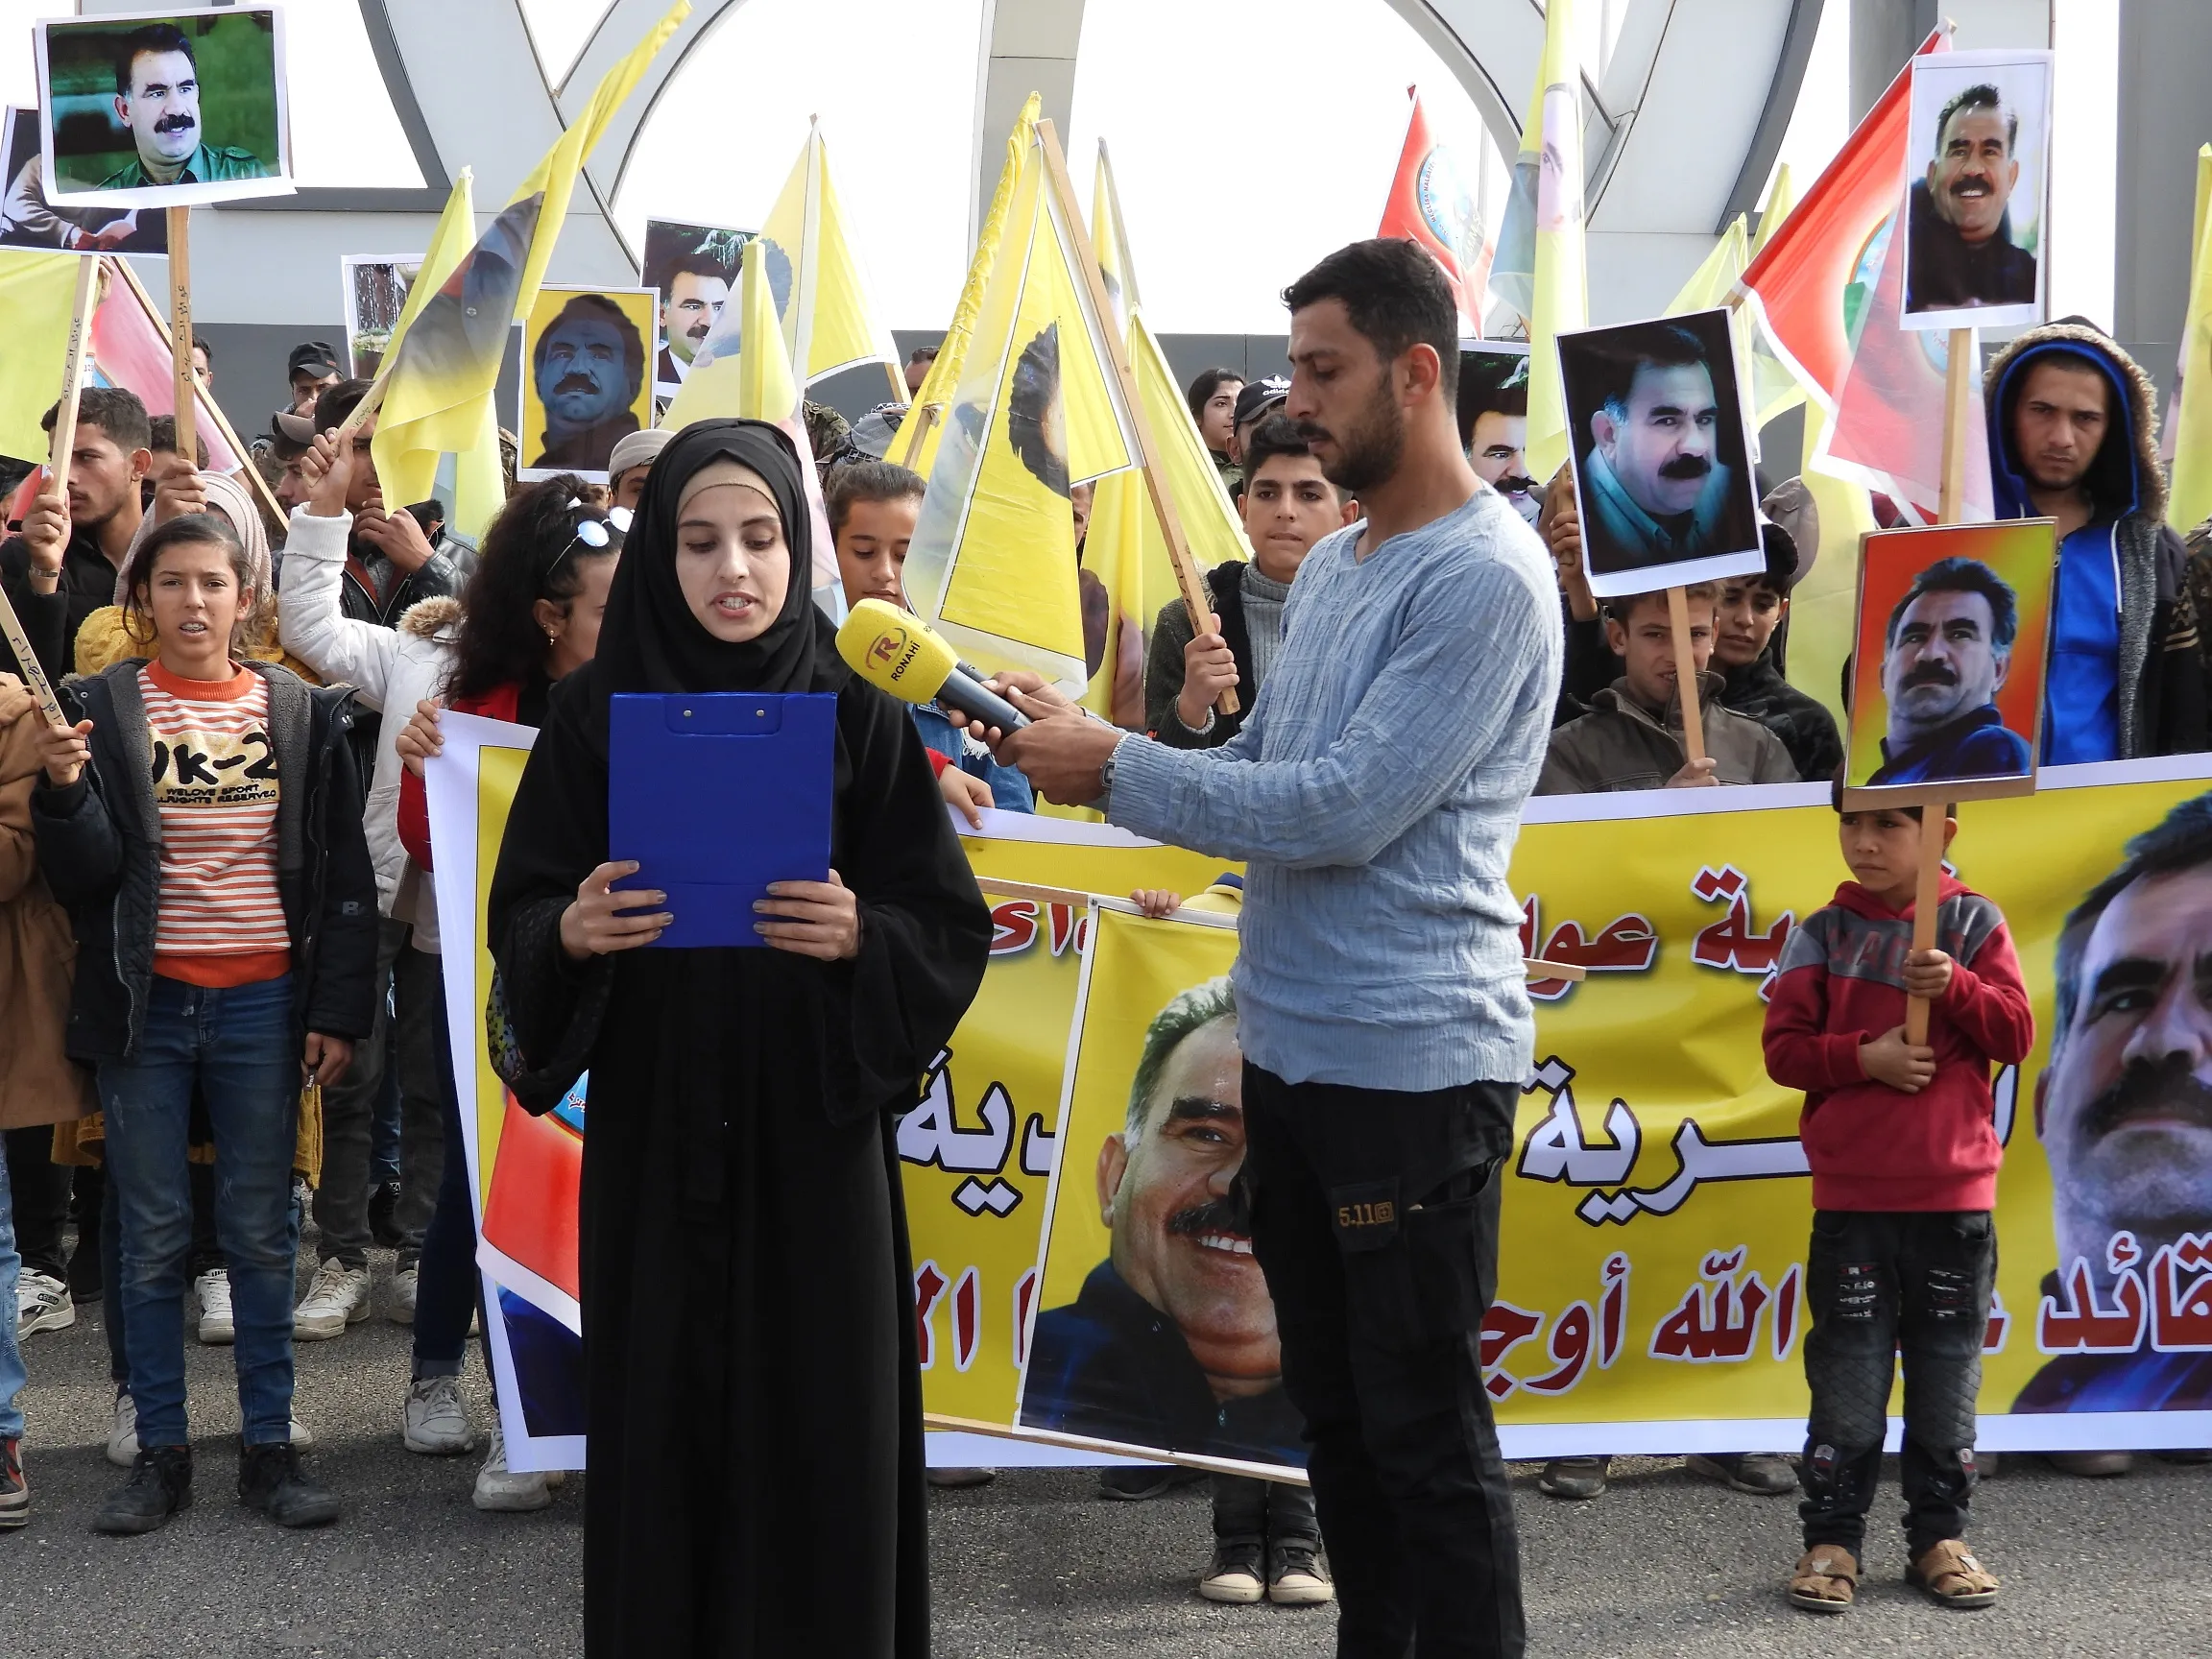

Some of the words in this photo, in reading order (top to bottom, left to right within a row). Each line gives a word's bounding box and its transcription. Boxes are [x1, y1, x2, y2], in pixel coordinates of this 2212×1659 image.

[1337, 1202, 1376, 1228] 5.11
[1479, 1250, 1631, 1404] أوج
[2035, 1230, 2212, 1355] قائد
